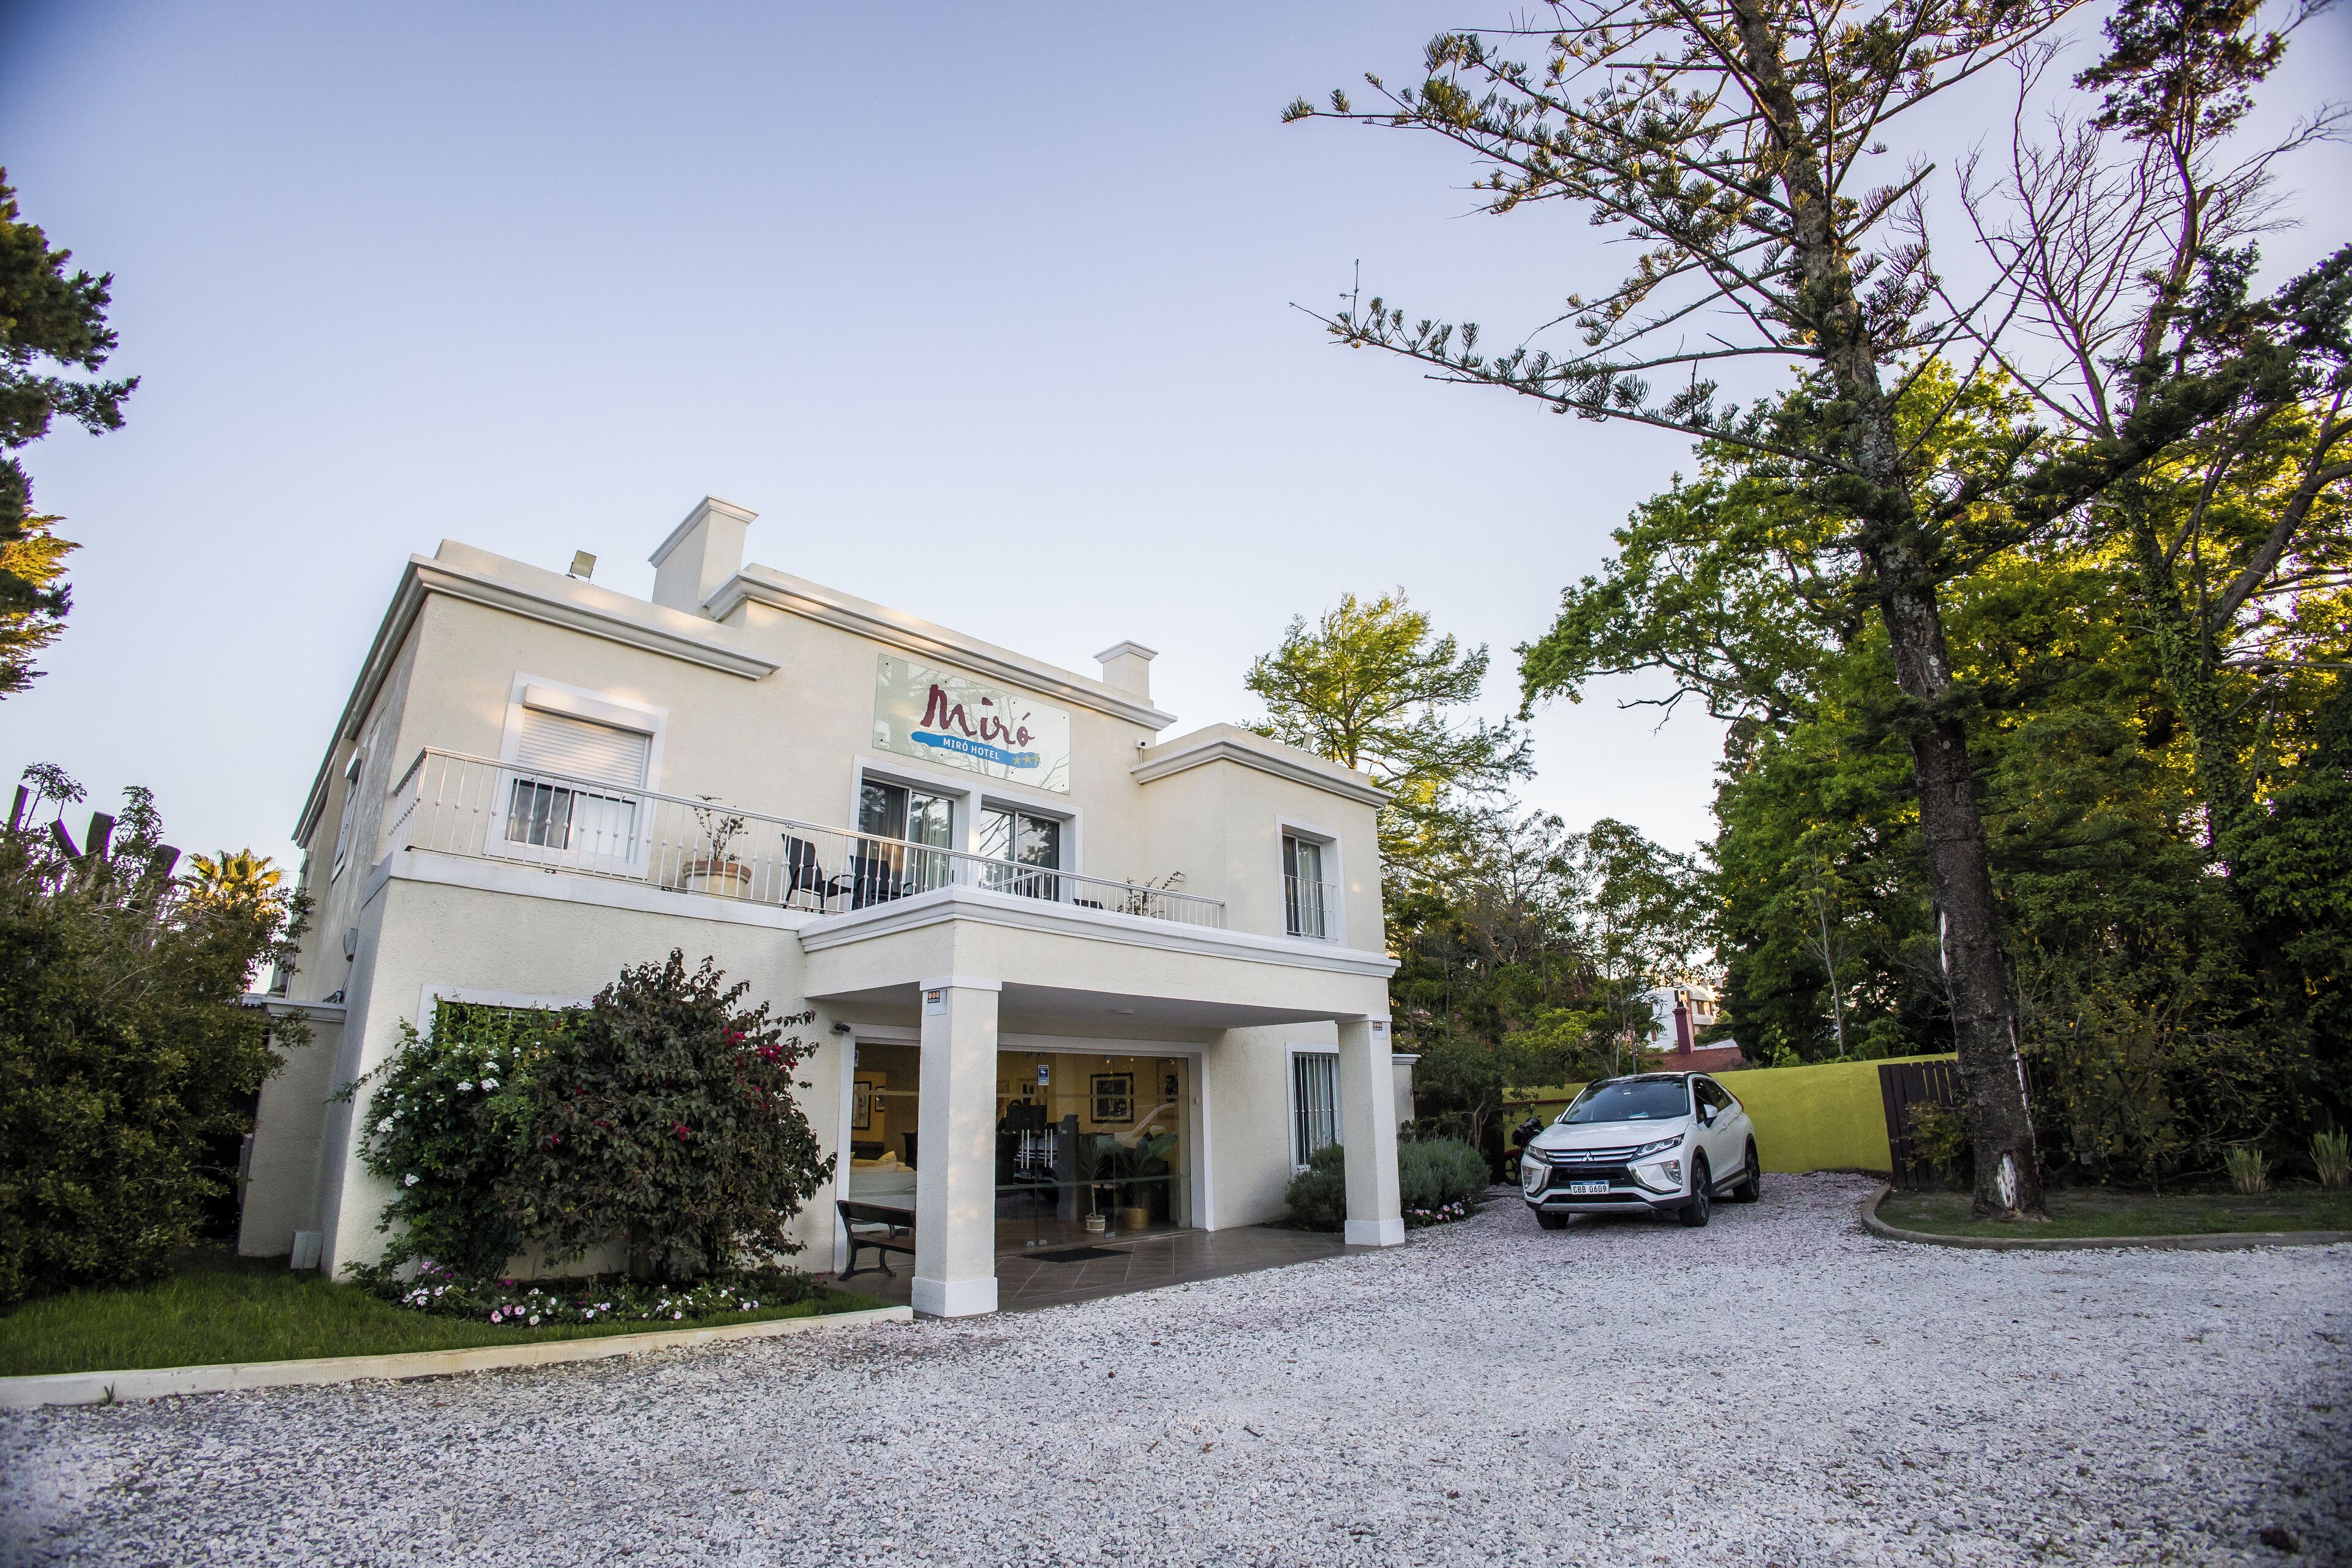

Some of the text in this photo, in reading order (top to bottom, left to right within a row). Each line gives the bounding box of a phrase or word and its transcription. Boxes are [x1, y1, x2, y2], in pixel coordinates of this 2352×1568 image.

[920, 684, 1035, 747] Miró
[943, 737, 1000, 760] MIRÓ HOTEL
